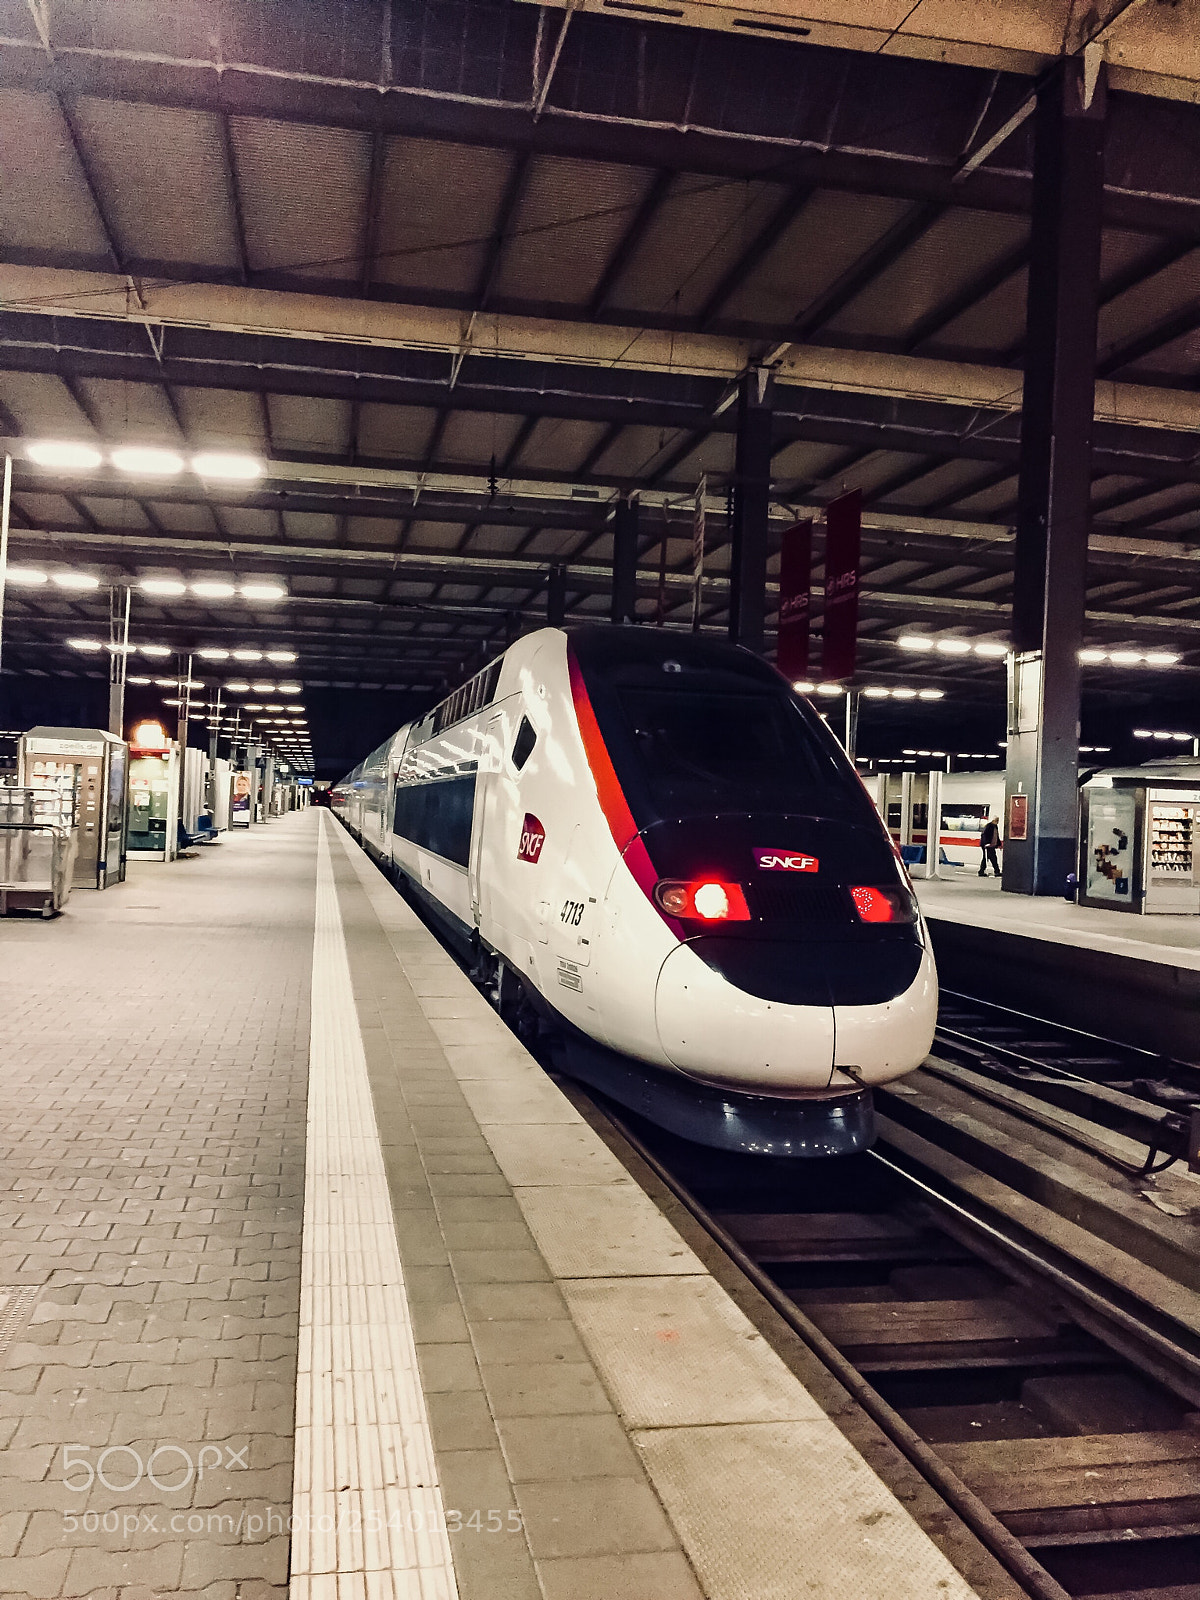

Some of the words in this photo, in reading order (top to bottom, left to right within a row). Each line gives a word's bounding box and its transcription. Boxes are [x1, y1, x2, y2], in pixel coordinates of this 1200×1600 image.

[519, 831, 544, 857] SNCF
[759, 855, 815, 869] SNCF
[560, 899, 585, 927] 4713
